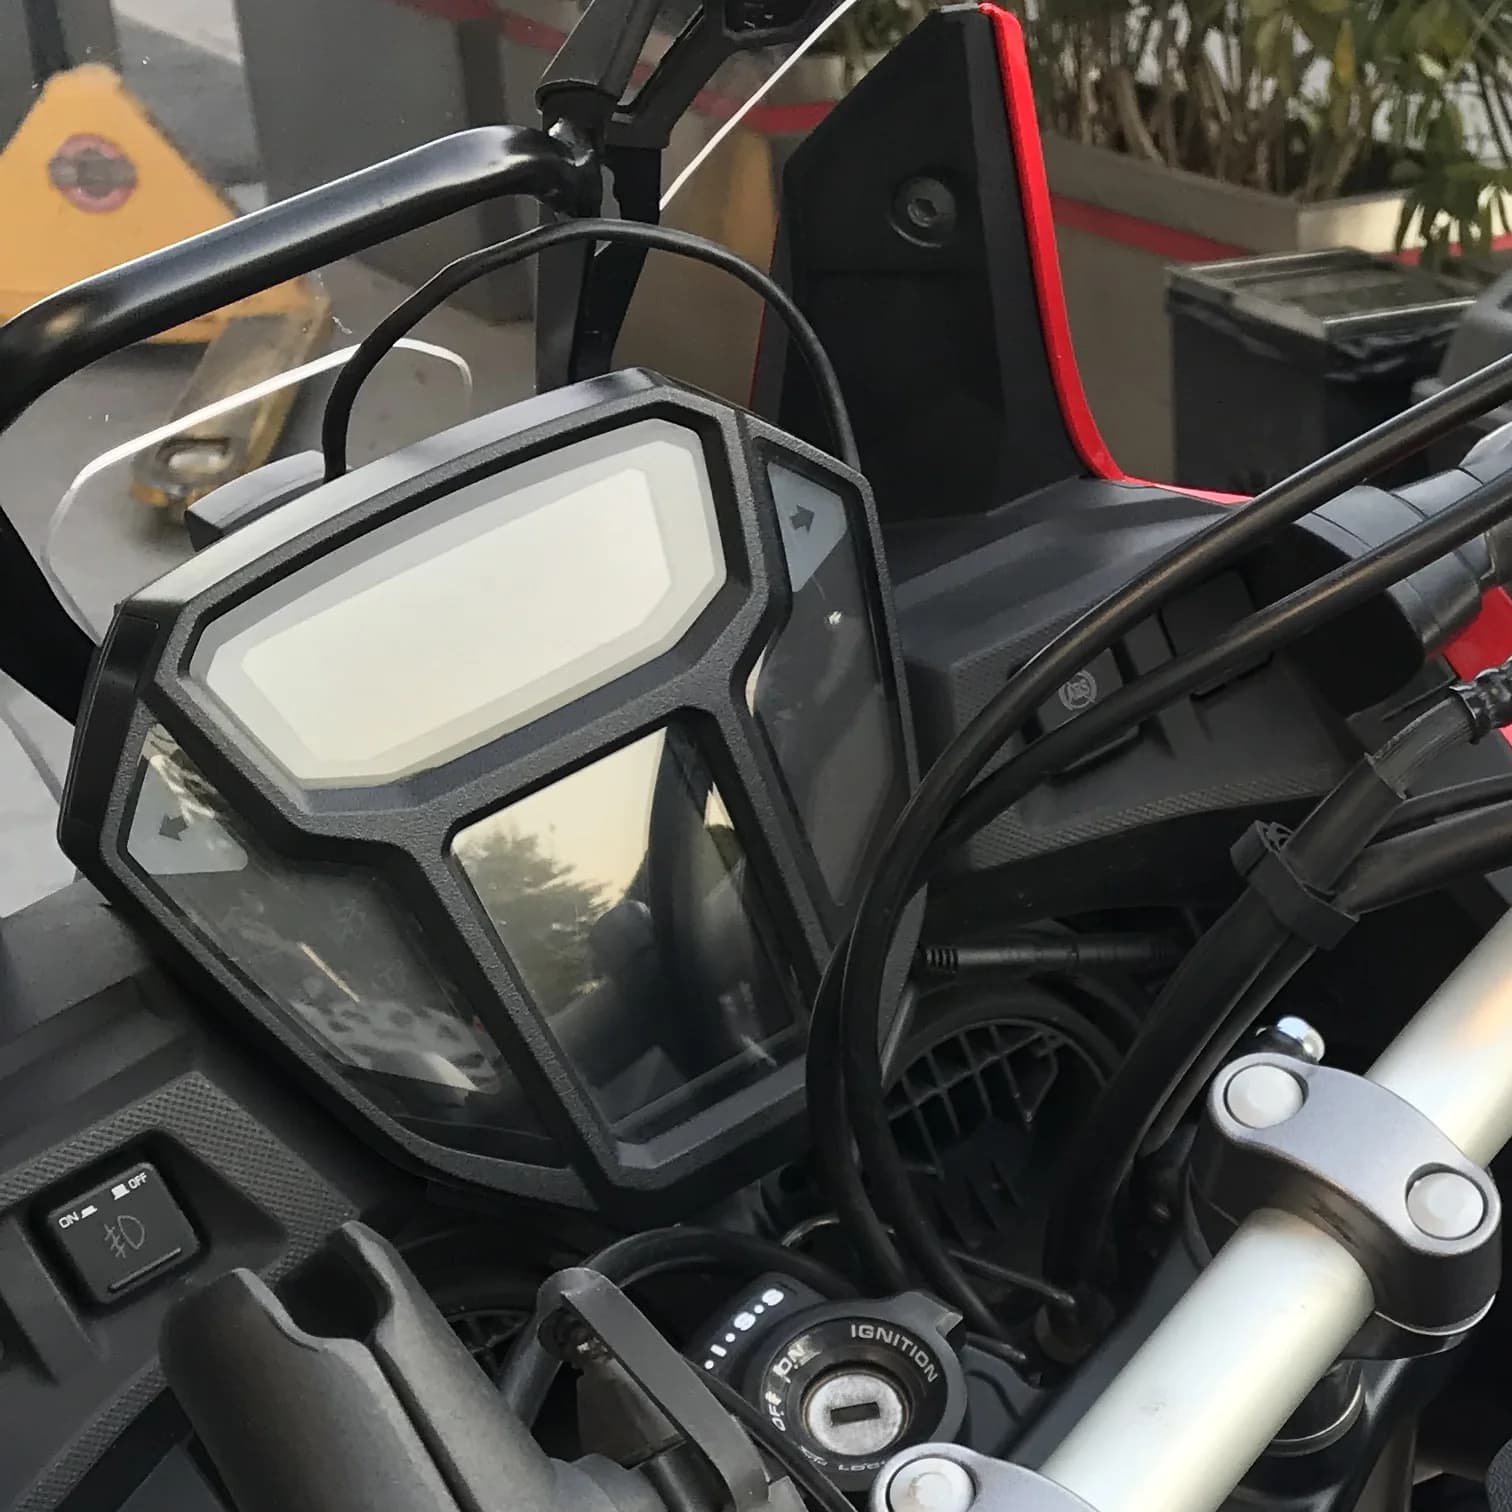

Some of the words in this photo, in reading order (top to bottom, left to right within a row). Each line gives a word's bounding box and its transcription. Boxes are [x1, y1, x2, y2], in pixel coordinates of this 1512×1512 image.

[57, 1211, 80, 1230] ON
[127, 1171, 148, 1190] OFF
[850, 1323, 940, 1384] IGNITION
